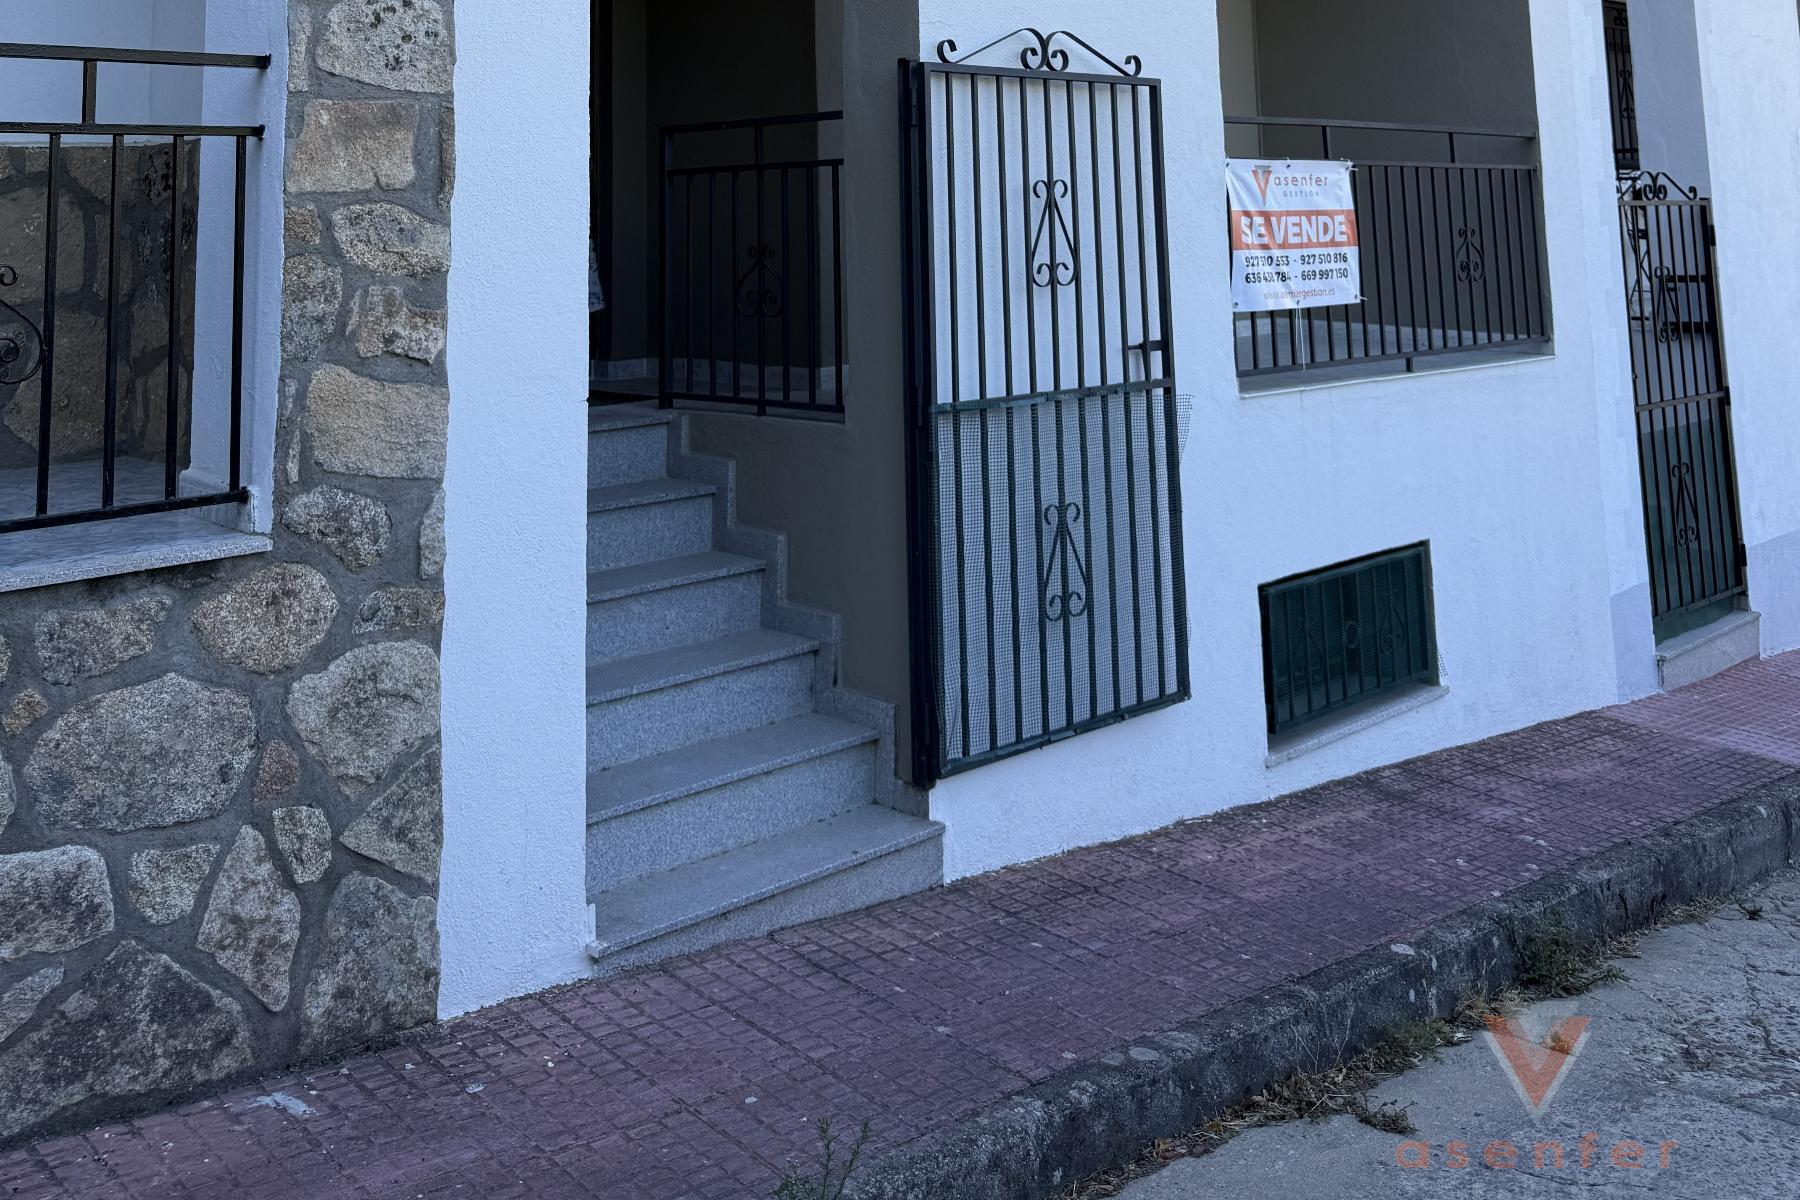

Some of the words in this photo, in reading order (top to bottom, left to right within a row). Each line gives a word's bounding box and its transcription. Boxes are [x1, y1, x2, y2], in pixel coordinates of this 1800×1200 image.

[1274, 174, 1328, 187] asenfer
[1240, 216, 1269, 245] SE
[1270, 215, 1348, 244] VENDE
[1245, 255, 1259, 268] 927
[1300, 254, 1316, 266] 927
[1318, 253, 1332, 265] 510
[1333, 252, 1348, 264] 816
[1245, 272, 1262, 284] 636
[1301, 269, 1317, 281] 669
[1318, 268, 1334, 280] 997
[1334, 267, 1349, 279] 150
